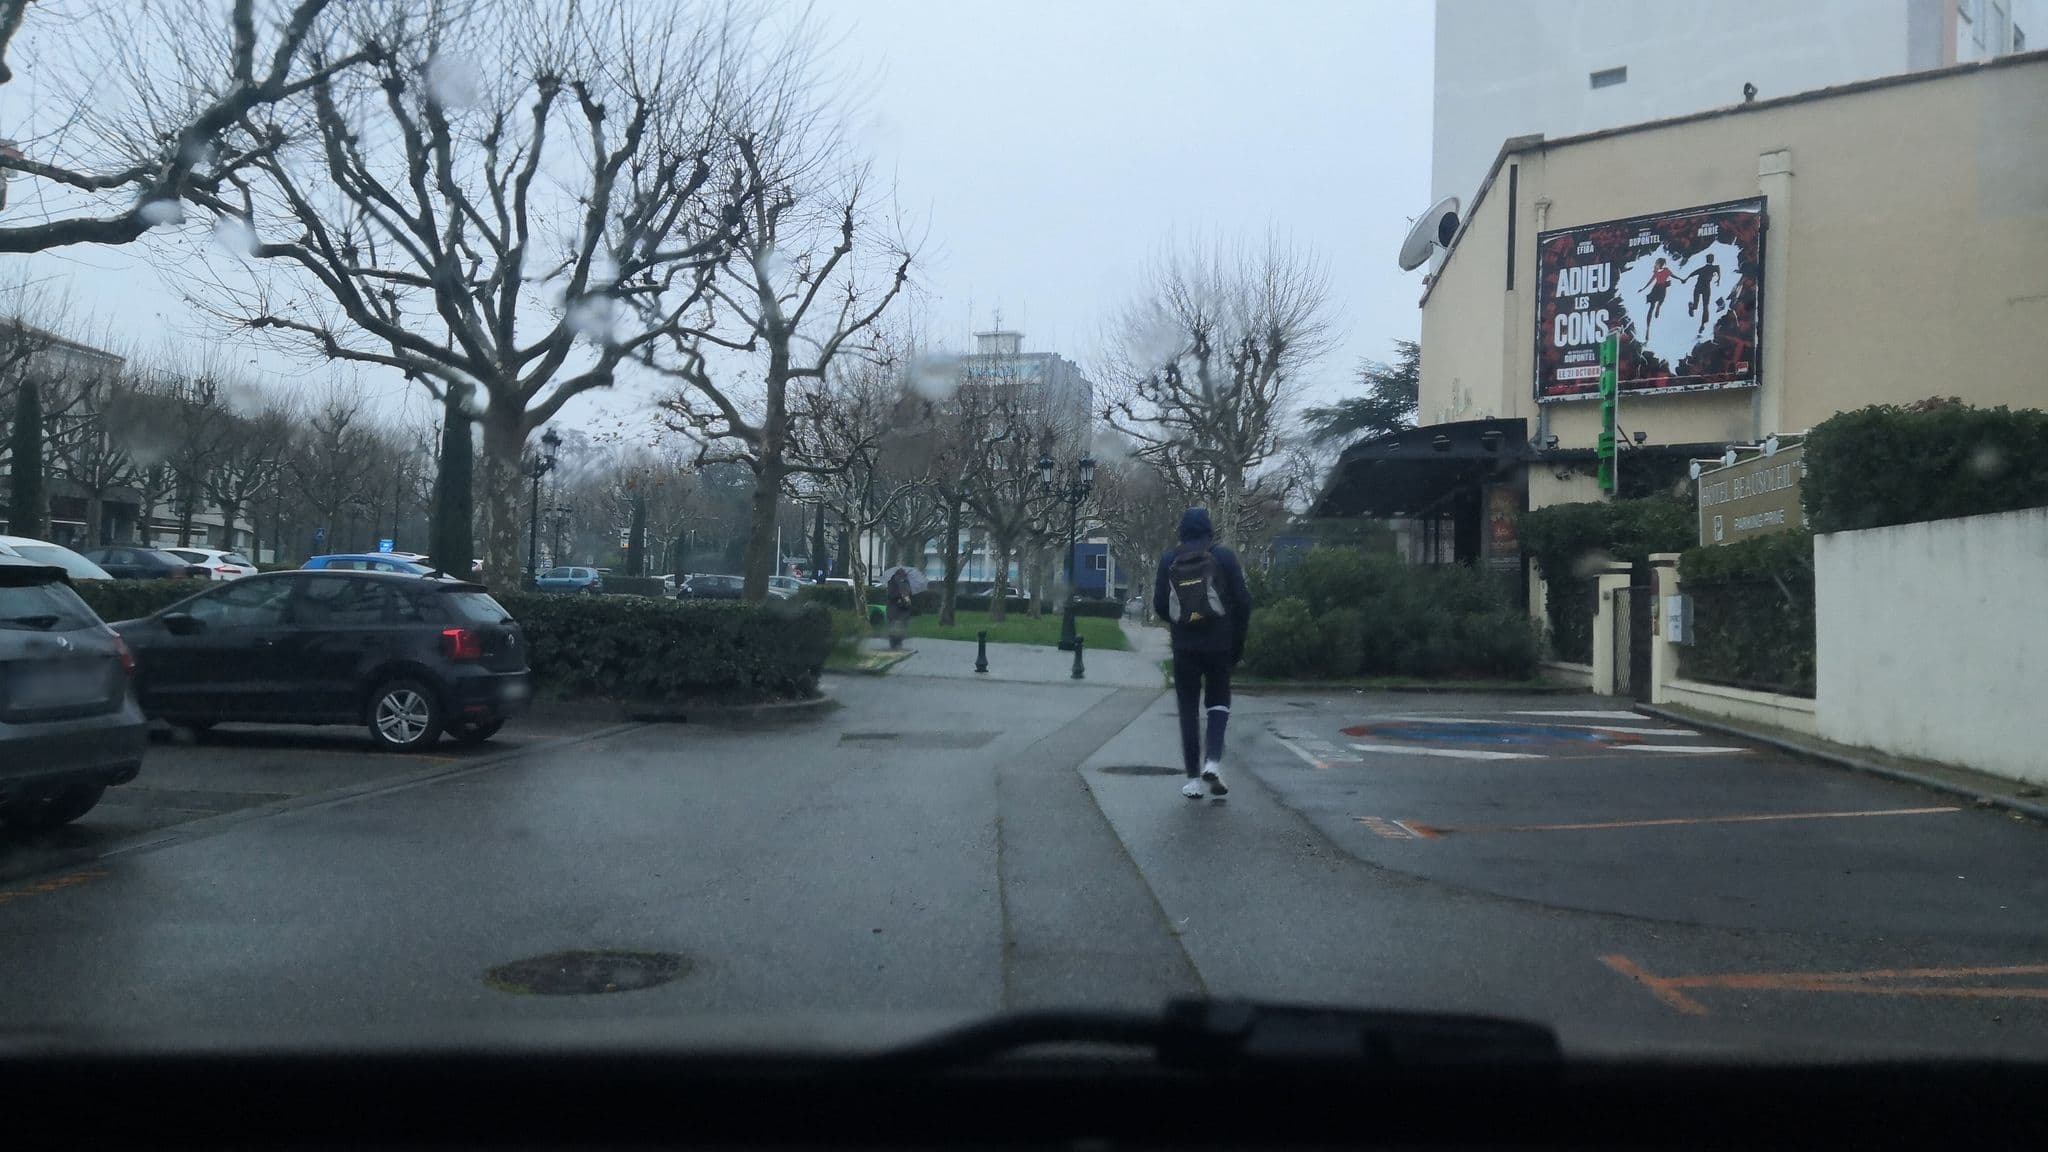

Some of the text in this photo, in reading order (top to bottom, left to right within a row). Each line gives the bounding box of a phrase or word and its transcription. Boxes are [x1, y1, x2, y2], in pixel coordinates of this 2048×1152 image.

[1697, 225, 1719, 237] MARIE
[1629, 234, 1661, 247] DUPONTEL
[1556, 262, 1610, 297] ADIEU
[1575, 296, 1590, 310] LES
[1554, 309, 1610, 347] CONS
[1558, 370, 1566, 379] LE
[1575, 367, 1600, 377] OCTOBR
[1734, 464, 1793, 499] BEAUSOLEIL
